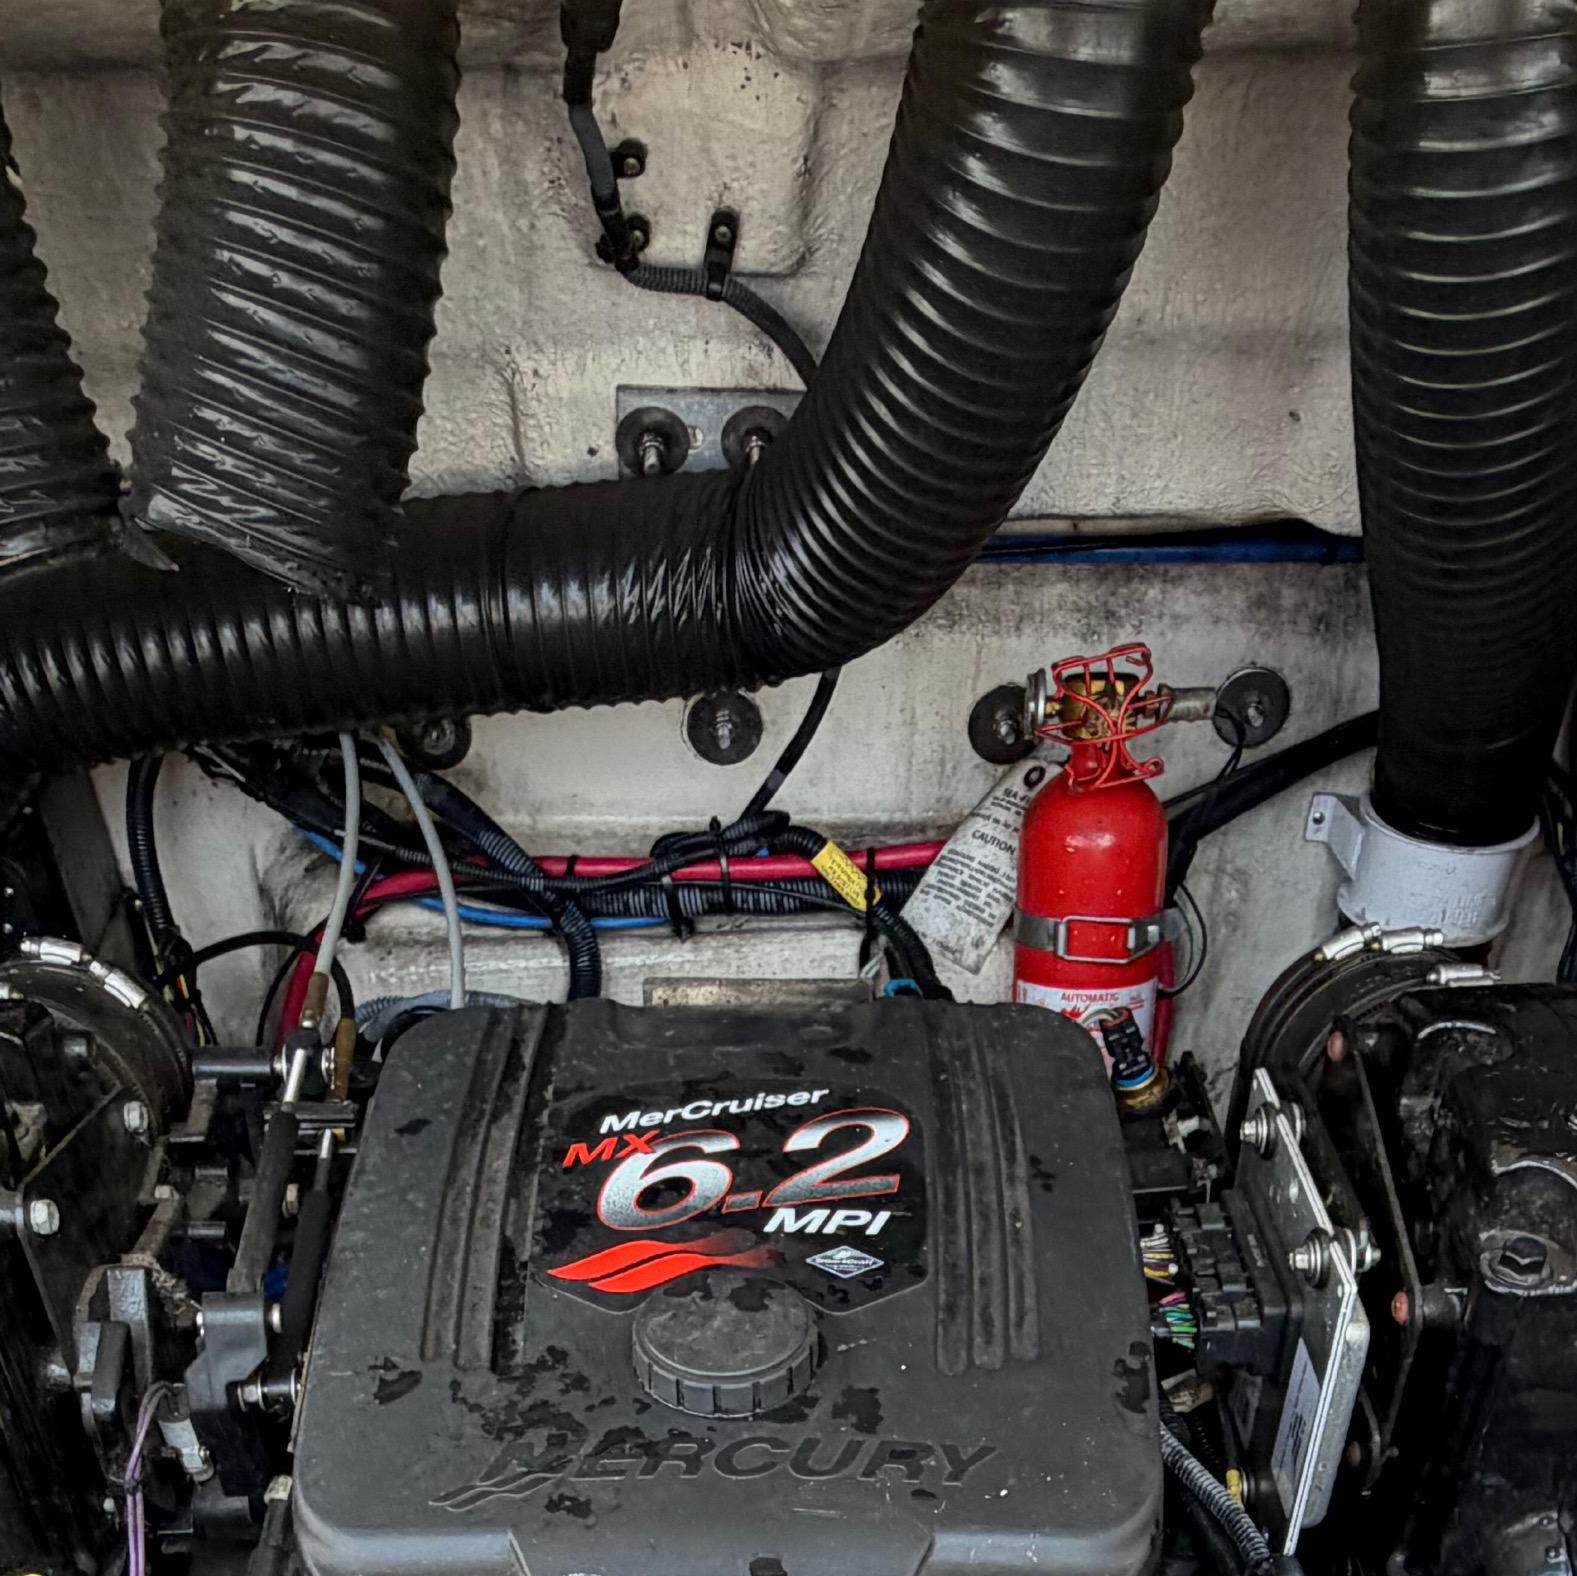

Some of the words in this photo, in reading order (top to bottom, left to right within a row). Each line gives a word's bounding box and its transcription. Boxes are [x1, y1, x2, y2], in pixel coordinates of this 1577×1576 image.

[971, 829, 1017, 857] CAUTION
[1060, 991, 1121, 1004] AUTOMATIC
[600, 1089, 830, 1135] MerCruiser
[562, 1130, 661, 1168] MX
[596, 1107, 911, 1231] 6.2
[763, 1207, 892, 1236] MPI
[476, 1436, 997, 1487] MERCURY
